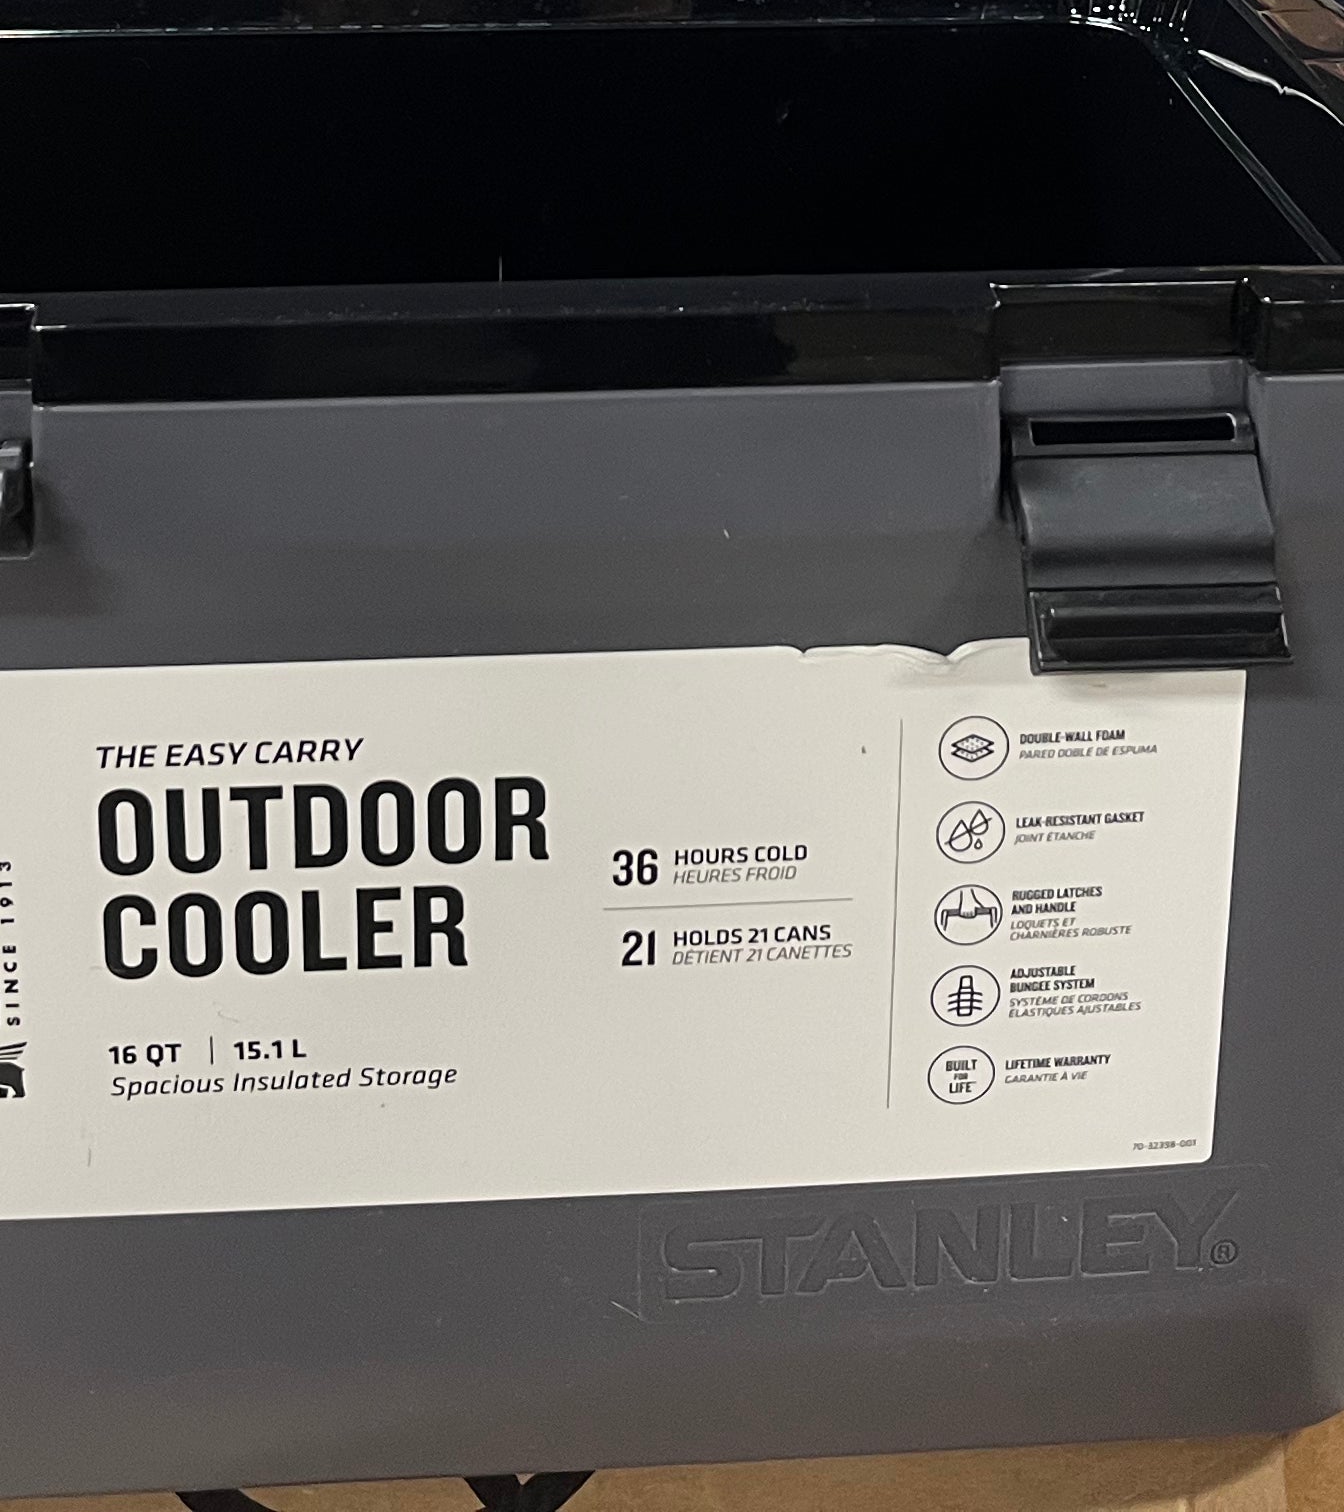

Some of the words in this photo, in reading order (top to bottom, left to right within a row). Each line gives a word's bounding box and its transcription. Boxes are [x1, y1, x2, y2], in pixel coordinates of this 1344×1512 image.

[1019, 731, 1093, 745] DOUBLE-WALL
[1095, 729, 1126, 742] FOAM
[95, 744, 157, 769] THE
[164, 741, 248, 768] EASY
[255, 737, 365, 765] CARRY
[1019, 748, 1056, 760] PARED
[1057, 746, 1093, 758] DOBLE
[1095, 746, 1110, 757] DE
[1112, 744, 1158, 756] ESPUMA
[97, 775, 550, 877] OUTDOOR
[1016, 813, 1103, 829] LEAK-RESISTANT
[1104, 811, 1145, 825] GASKET
[1014, 832, 1045, 846] JOINT
[674, 847, 748, 866] HOURS
[755, 844, 808, 863] COLD
[612, 849, 658, 886] 36
[672, 867, 742, 885] HEURES
[745, 865, 798, 882] FROID
[1012, 888, 1054, 901] RUGGED
[1056, 886, 1103, 899] LATCHES
[1011, 903, 1033, 915] AND
[1035, 901, 1077, 915] HANDLE
[102, 885, 468, 980] COOLER
[1010, 918, 1060, 931] LOQUETS
[1062, 917, 1076, 927] ET
[1081, 925, 1132, 937] ROBUSTE
[673, 928, 743, 947] HOLDS
[748, 928, 768, 944] 21
[773, 924, 832, 943] CANS
[621, 929, 656, 967] 21
[746, 949, 764, 962] 21
[766, 943, 853, 962] CANETTES
[1010, 965, 1076, 979] ADJUSTABLE
[2, 944, 22, 1027] SINCE
[1010, 980, 1051, 993] BUNGEE
[1053, 978, 1095, 991] SYSTEM
[1060, 994, 1076, 1004] DE
[1077, 991, 1129, 1004] CORDONS
[1076, 1001, 1142, 1016] AJUSTABLES
[108, 1045, 138, 1065] 16
[146, 1043, 182, 1067] QT
[233, 1039, 284, 1061] 15.1
[292, 1038, 308, 1058] L
[946, 1059, 977, 1072] BUILT
[1005, 1057, 1052, 1070] LIFETIME
[1054, 1054, 1112, 1068] WARRANTY
[110, 1074, 225, 1101] Spacious
[233, 1068, 352, 1093] Insulated
[359, 1066, 458, 1090] Storage
[1004, 1072, 1059, 1084] GARANTIE
[1071, 1070, 1089, 1081] VIE
